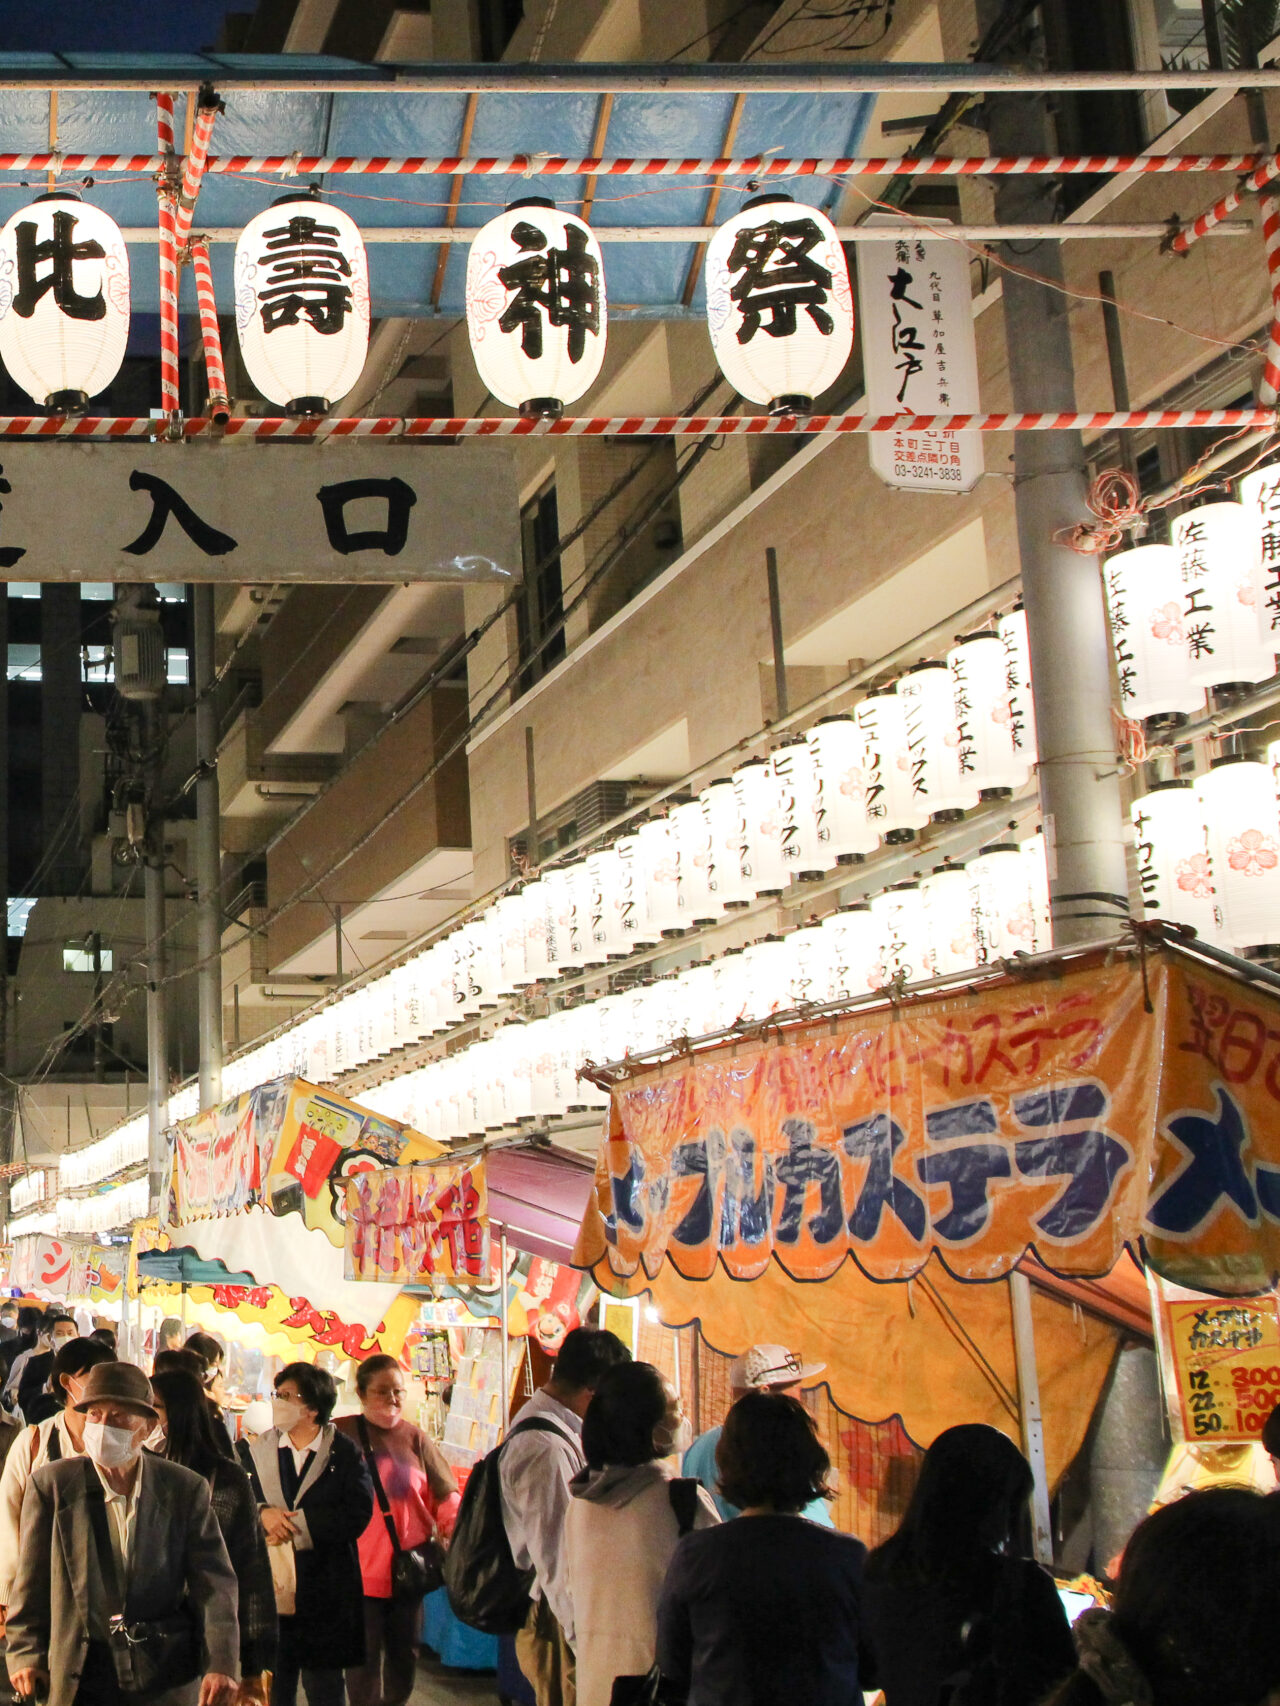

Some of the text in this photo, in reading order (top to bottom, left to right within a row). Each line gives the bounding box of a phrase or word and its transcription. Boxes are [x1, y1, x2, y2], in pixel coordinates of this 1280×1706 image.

[12, 210, 107, 321] 比
[498, 220, 600, 365] 神
[727, 218, 834, 344] 祭
[887, 267, 925, 403] 大江戸
[893, 438, 960, 453] 本町三丁目
[894, 464, 962, 481] 03-3241-3838
